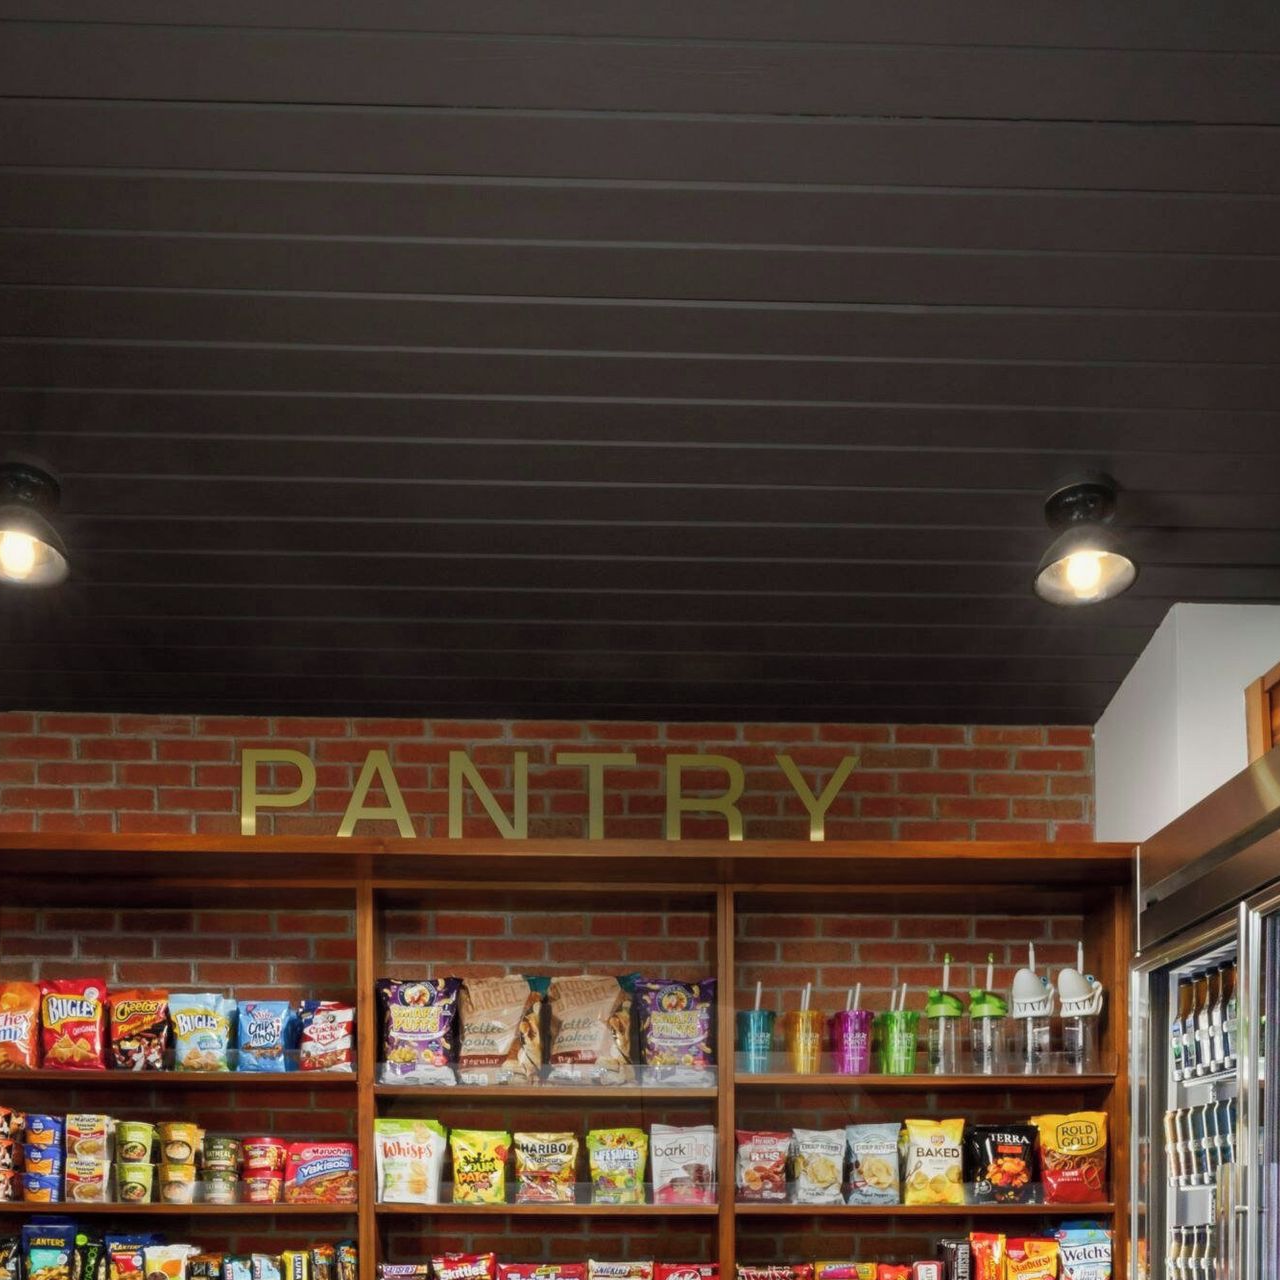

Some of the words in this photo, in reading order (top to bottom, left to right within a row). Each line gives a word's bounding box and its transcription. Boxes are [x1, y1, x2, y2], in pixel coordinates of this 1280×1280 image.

[240, 747, 860, 843] PANTRY
[47, 996, 97, 1024] BUGLES
[116, 1000, 158, 1022] Cheetos
[1061, 1124, 1094, 1136] ROLD
[990, 1132, 1031, 1144] TERRA
[1061, 1136, 1095, 1148] GOLD
[311, 1148, 352, 1157] Maruchan
[382, 1141, 433, 1160] Whisps
[520, 1143, 567, 1154] HARIBO
[916, 1147, 960, 1158] BAKED
[300, 1160, 351, 1178] Yakisoba
[459, 1160, 496, 1173] SOUR
[1062, 1247, 1111, 1262] Welch's
[294, 1256, 303, 1280] LUNA
[594, 1266, 628, 1275] SNICKERS
